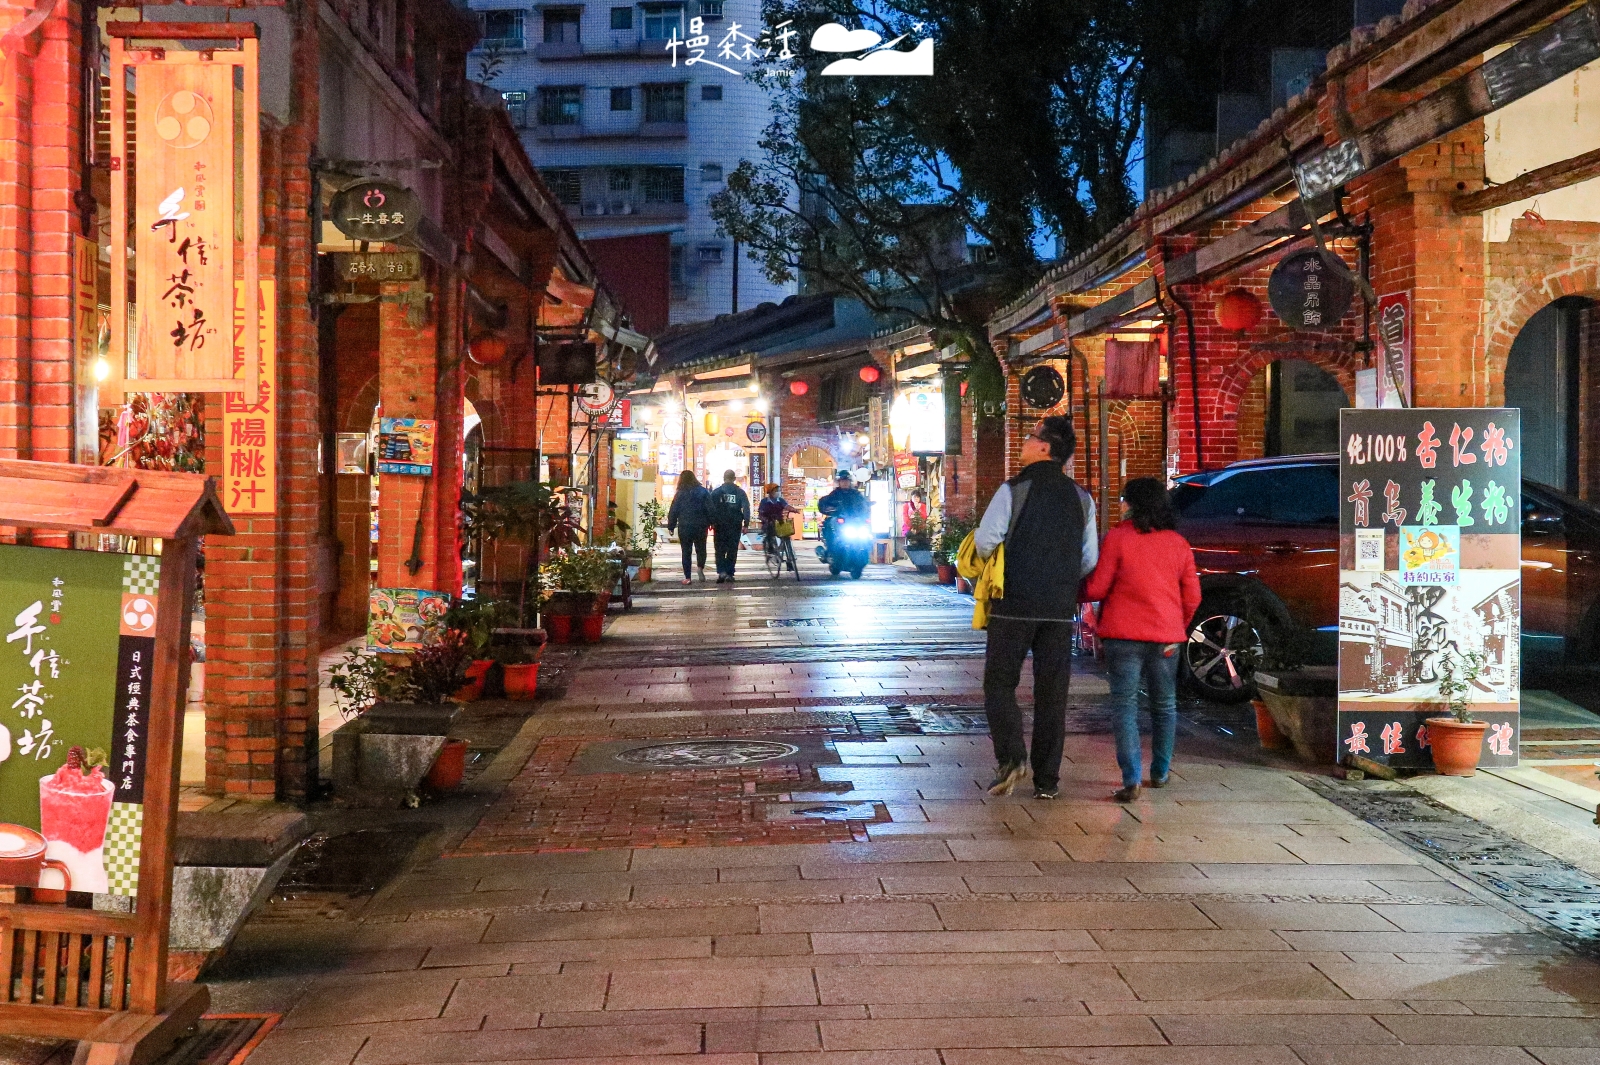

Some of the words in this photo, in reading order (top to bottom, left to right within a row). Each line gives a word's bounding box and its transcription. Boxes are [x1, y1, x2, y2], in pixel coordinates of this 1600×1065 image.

[346, 211, 405, 225] 一生喜愛
[151, 186, 208, 351] 手信茶坊
[1303, 257, 1322, 326] 水晶吊飾
[1415, 420, 1514, 469] 杏仁粉
[1403, 571, 1456, 583] 特約店家
[6, 600, 60, 761] 手信茶坊
[120, 650, 142, 790] 日式經典茶食專門店
[1343, 720, 1514, 756] 最佳禮
